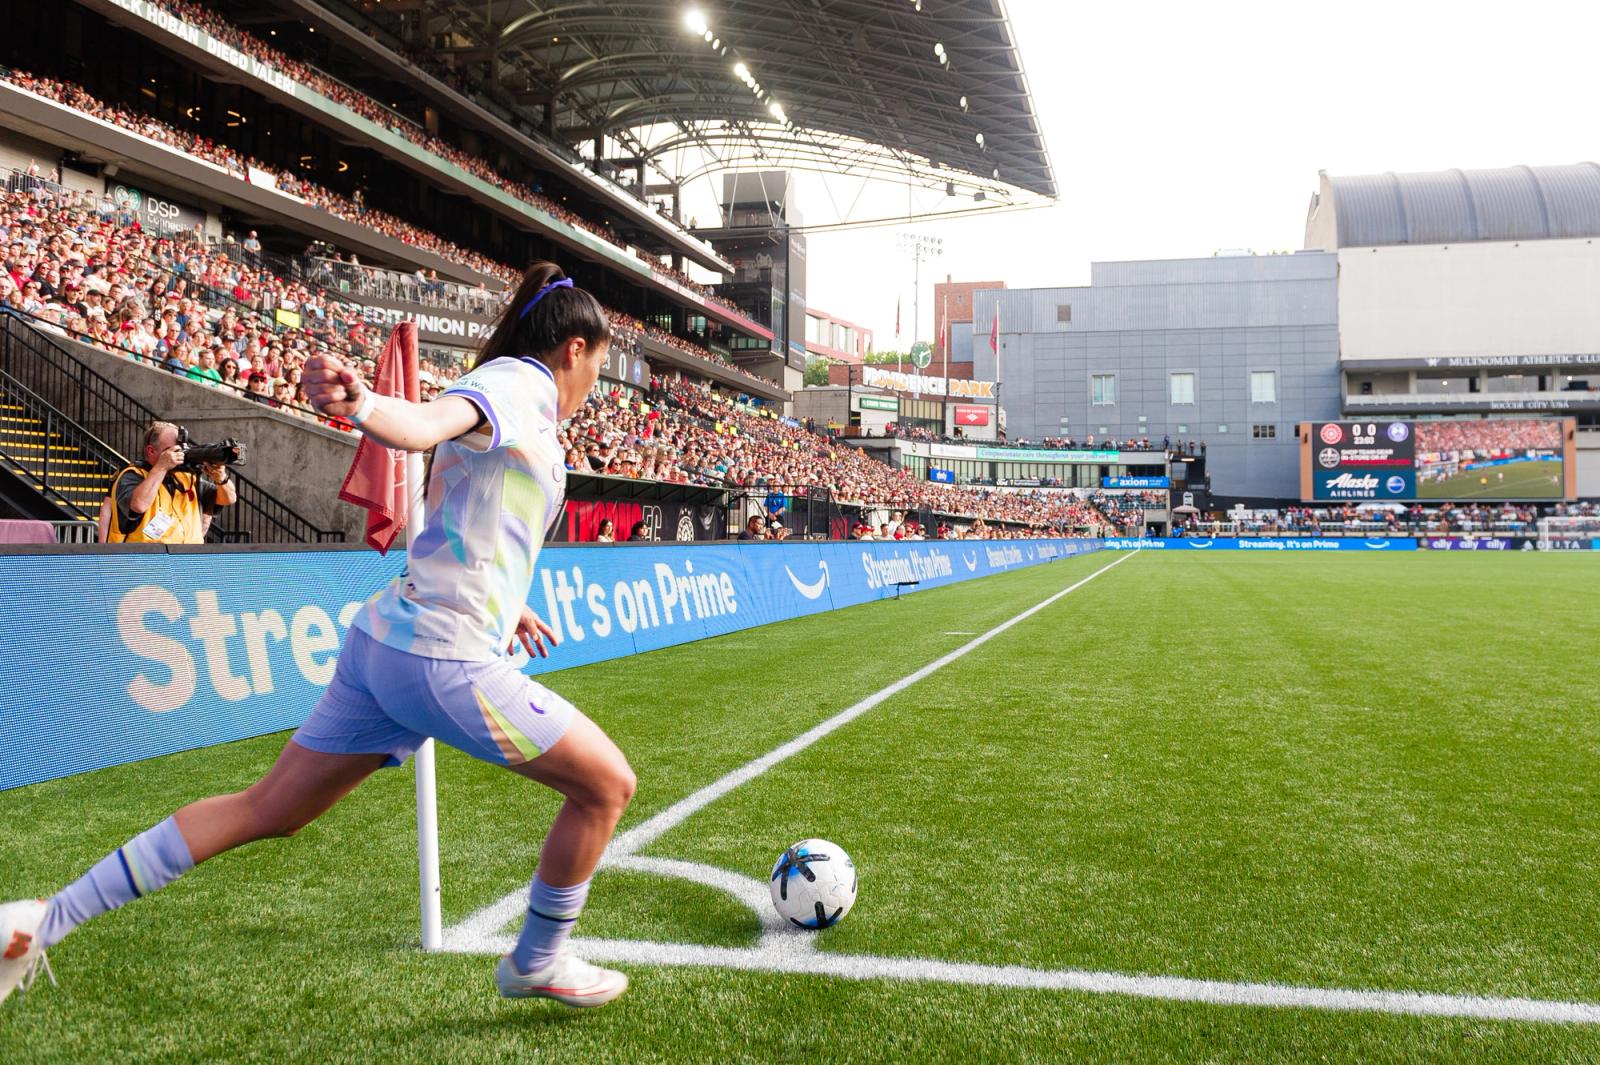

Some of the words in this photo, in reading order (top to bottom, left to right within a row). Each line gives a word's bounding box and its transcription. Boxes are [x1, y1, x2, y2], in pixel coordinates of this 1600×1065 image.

[147, 2, 199, 45] HOBAN
[207, 36, 248, 70] DIEGO
[251, 57, 296, 96] VALERI
[147, 197, 180, 219] DSP
[407, 312, 465, 337] UNION
[1523, 355, 1573, 365] ATHLETIC
[1576, 354, 1600, 364] CLU
[862, 366, 947, 396] PROVIDENCE
[949, 378, 995, 398] PARK
[1352, 424, 1361, 436] 0
[1367, 424, 1376, 436] 0
[1119, 477, 1149, 487] axiom
[1326, 473, 1379, 489] Alaska
[1238, 540, 1285, 550] Streaming.
[1313, 540, 1340, 548] Prime
[540, 566, 612, 643] It's
[613, 578, 661, 634] on
[654, 559, 738, 625] Prime
